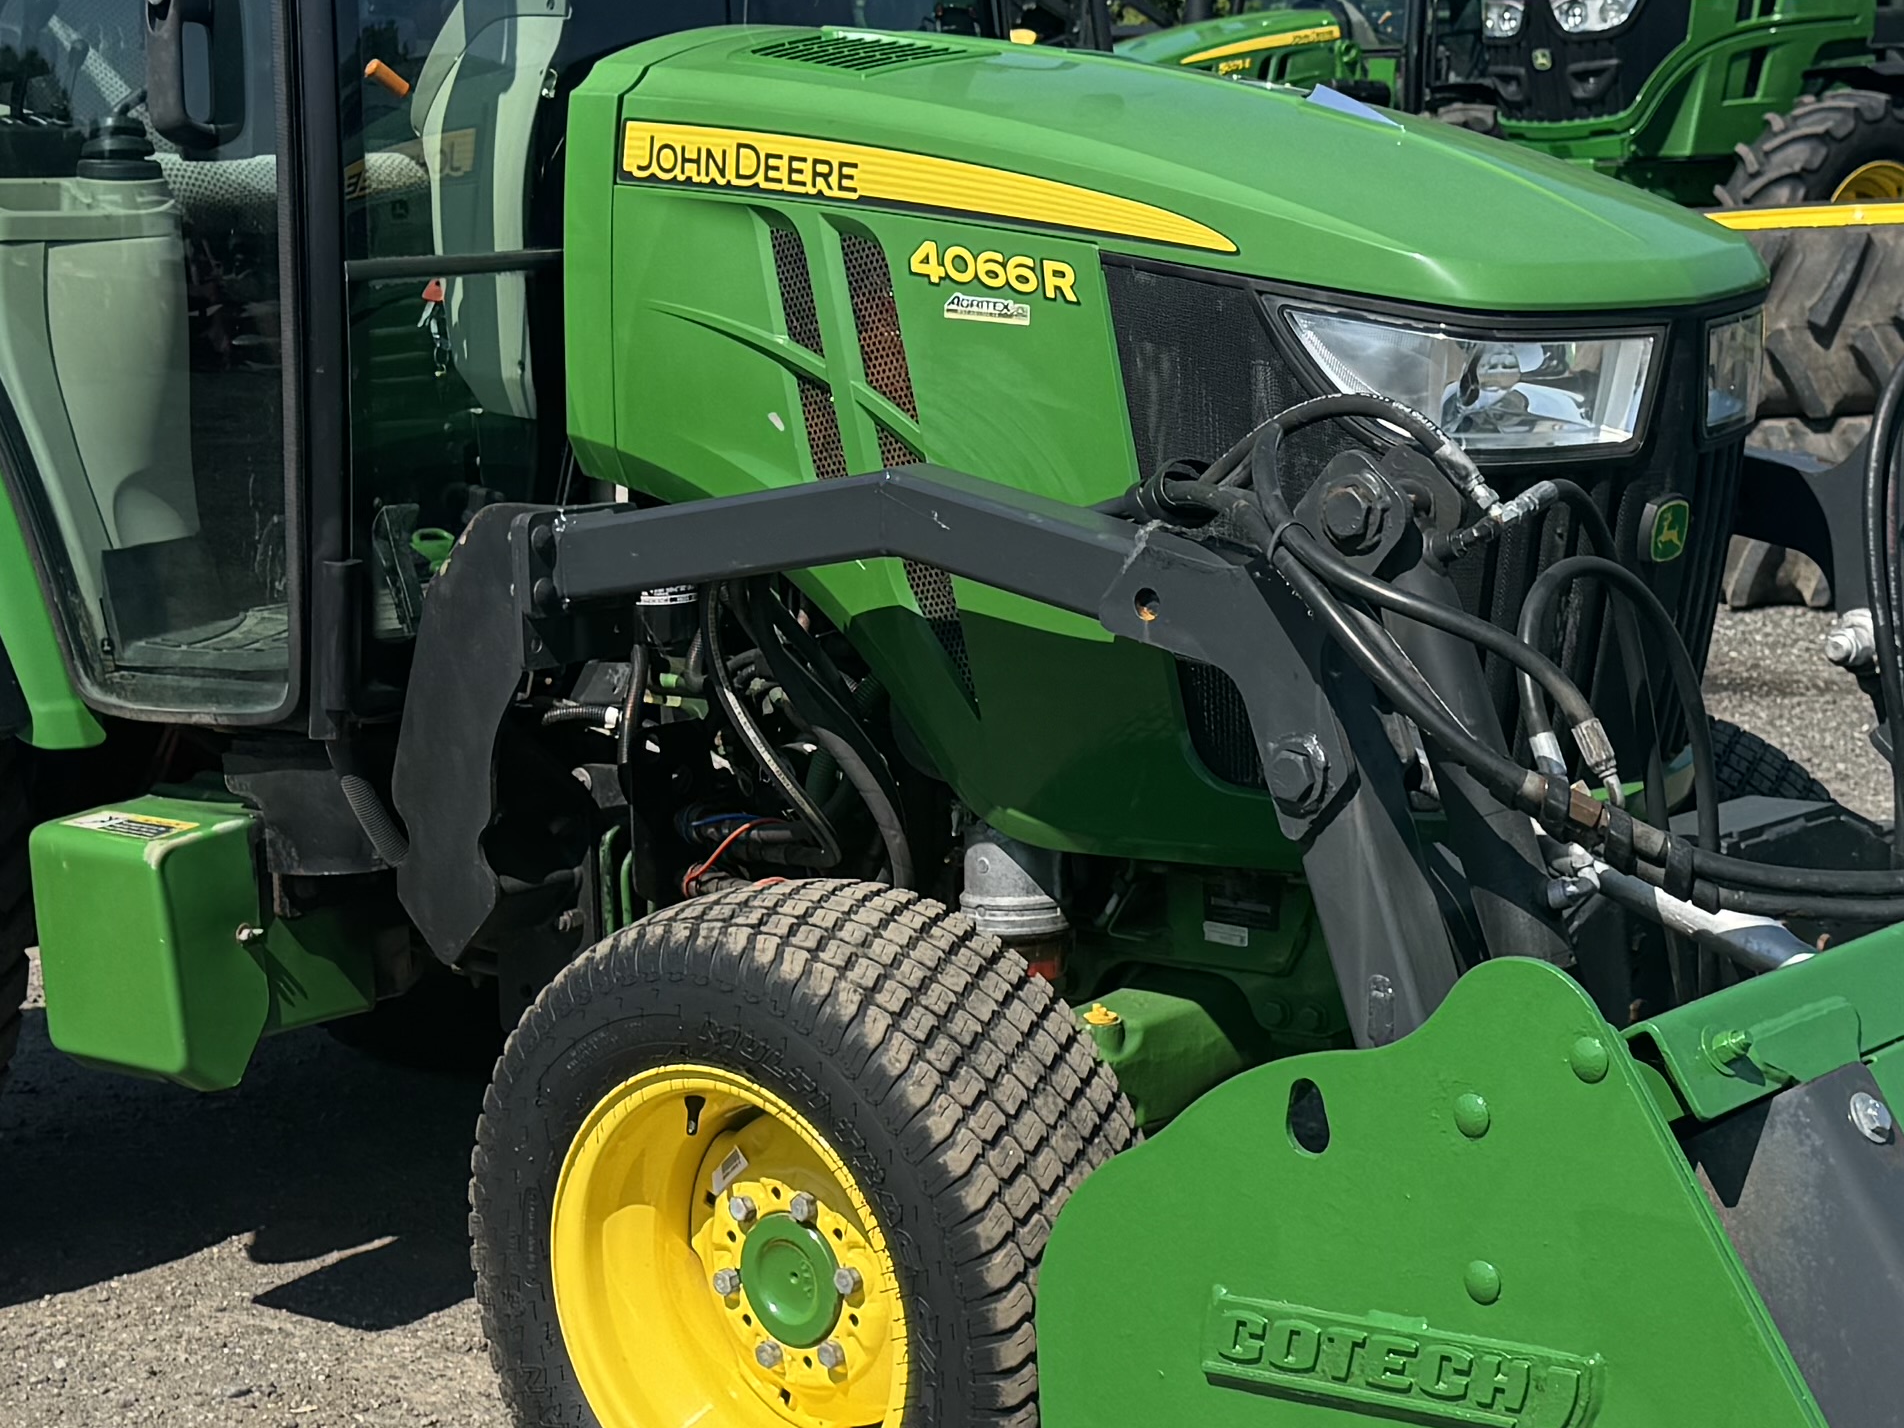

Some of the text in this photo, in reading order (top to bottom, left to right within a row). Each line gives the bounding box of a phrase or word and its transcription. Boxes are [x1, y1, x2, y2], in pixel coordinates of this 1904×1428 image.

[636, 134, 859, 194] JOHN DEERE
[1214, 1308, 1533, 1415] COTECH
